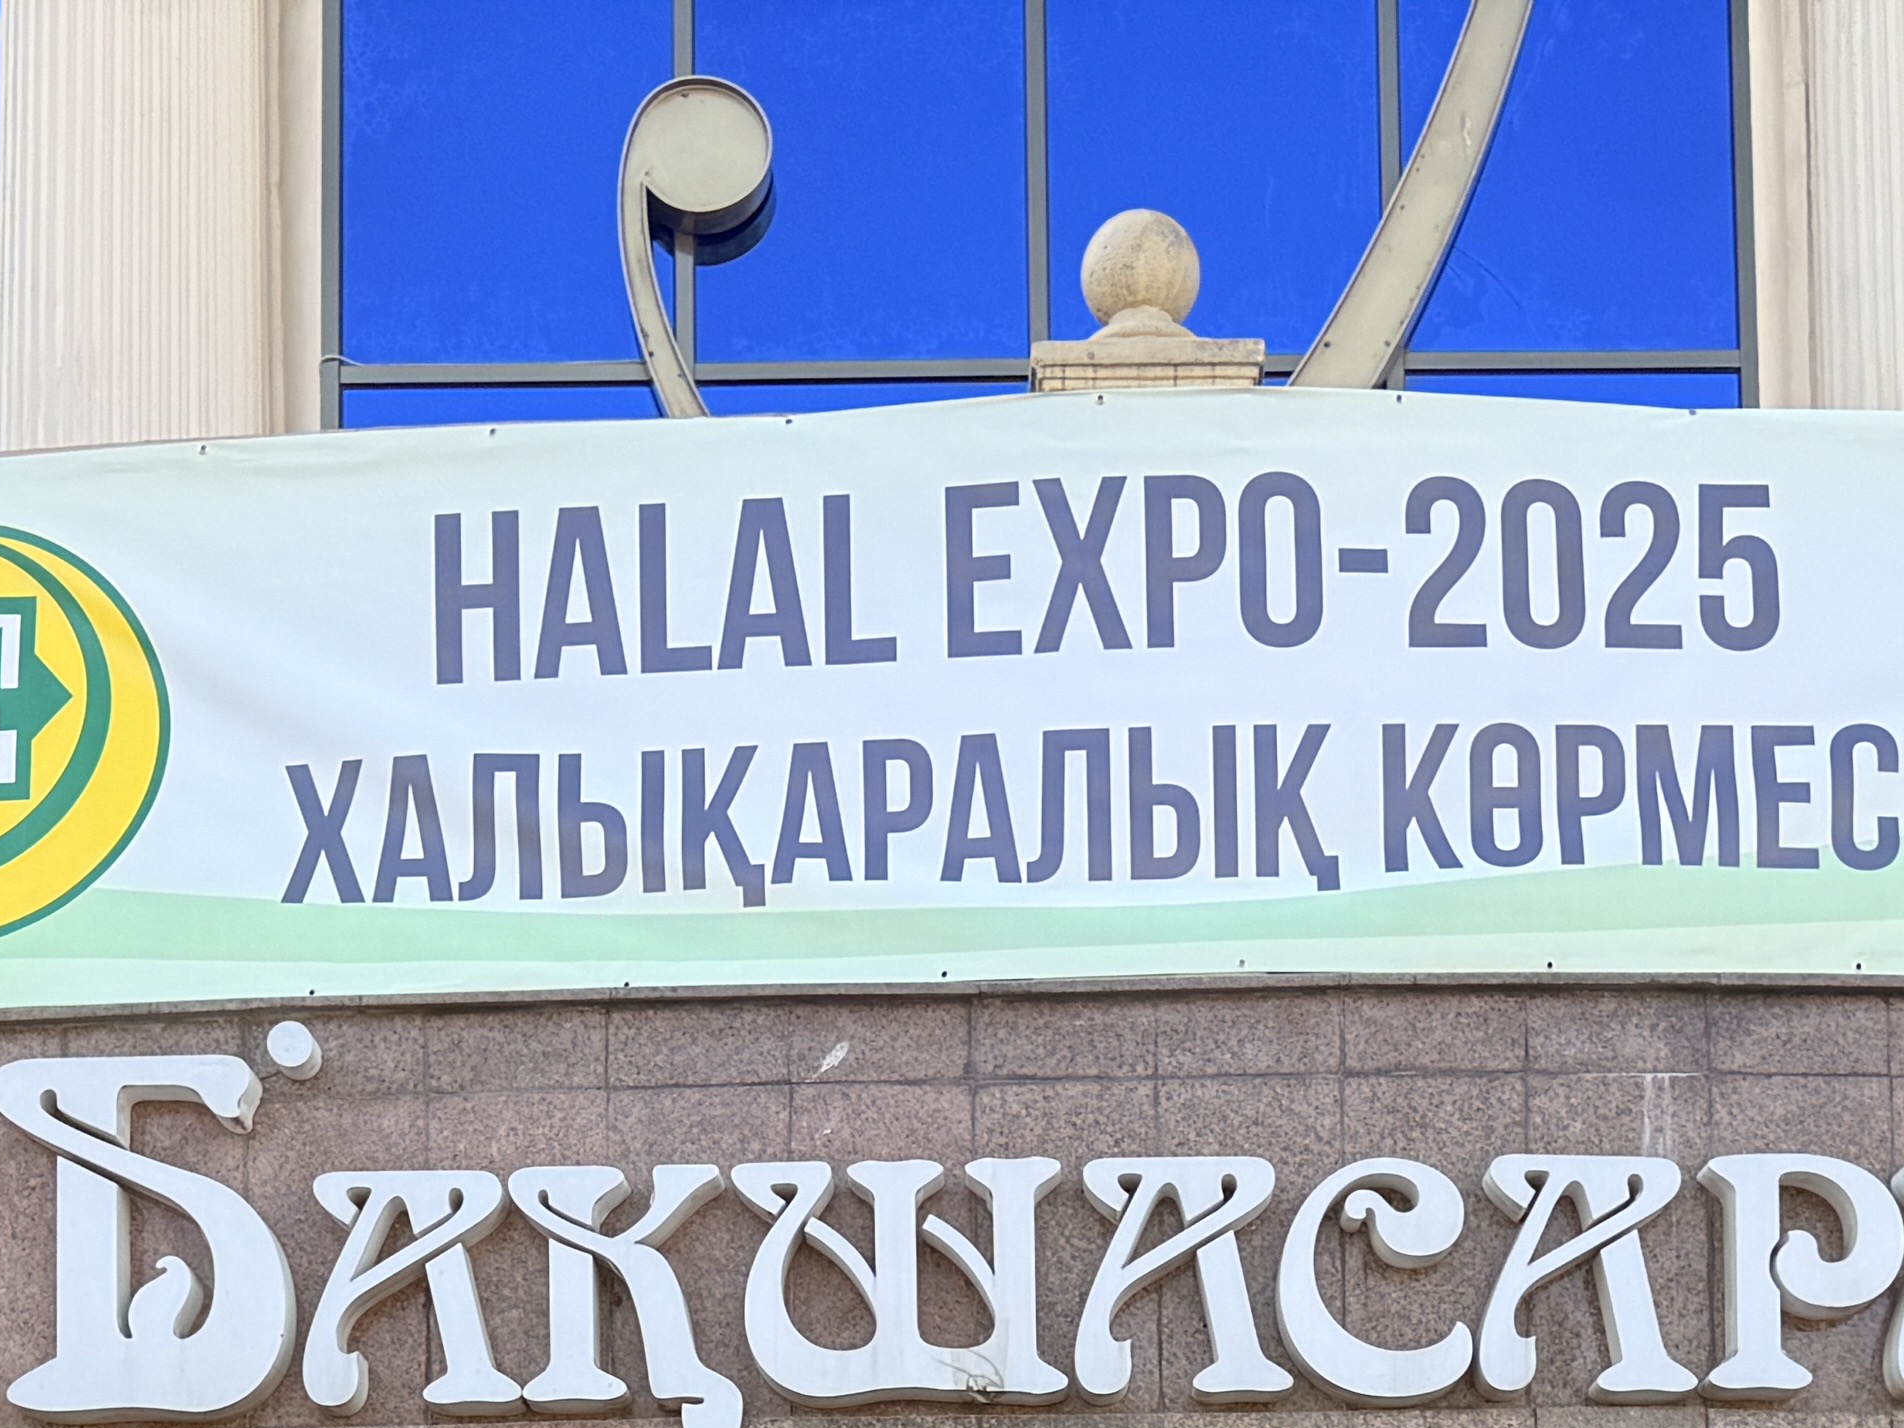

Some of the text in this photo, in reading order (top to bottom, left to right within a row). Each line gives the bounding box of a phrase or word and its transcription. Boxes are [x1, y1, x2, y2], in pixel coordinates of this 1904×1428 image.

[434, 471, 1782, 685] HALAL EXPO-2025
[281, 723, 1342, 909] ХАЛЫҚАРАЛЫҚ
